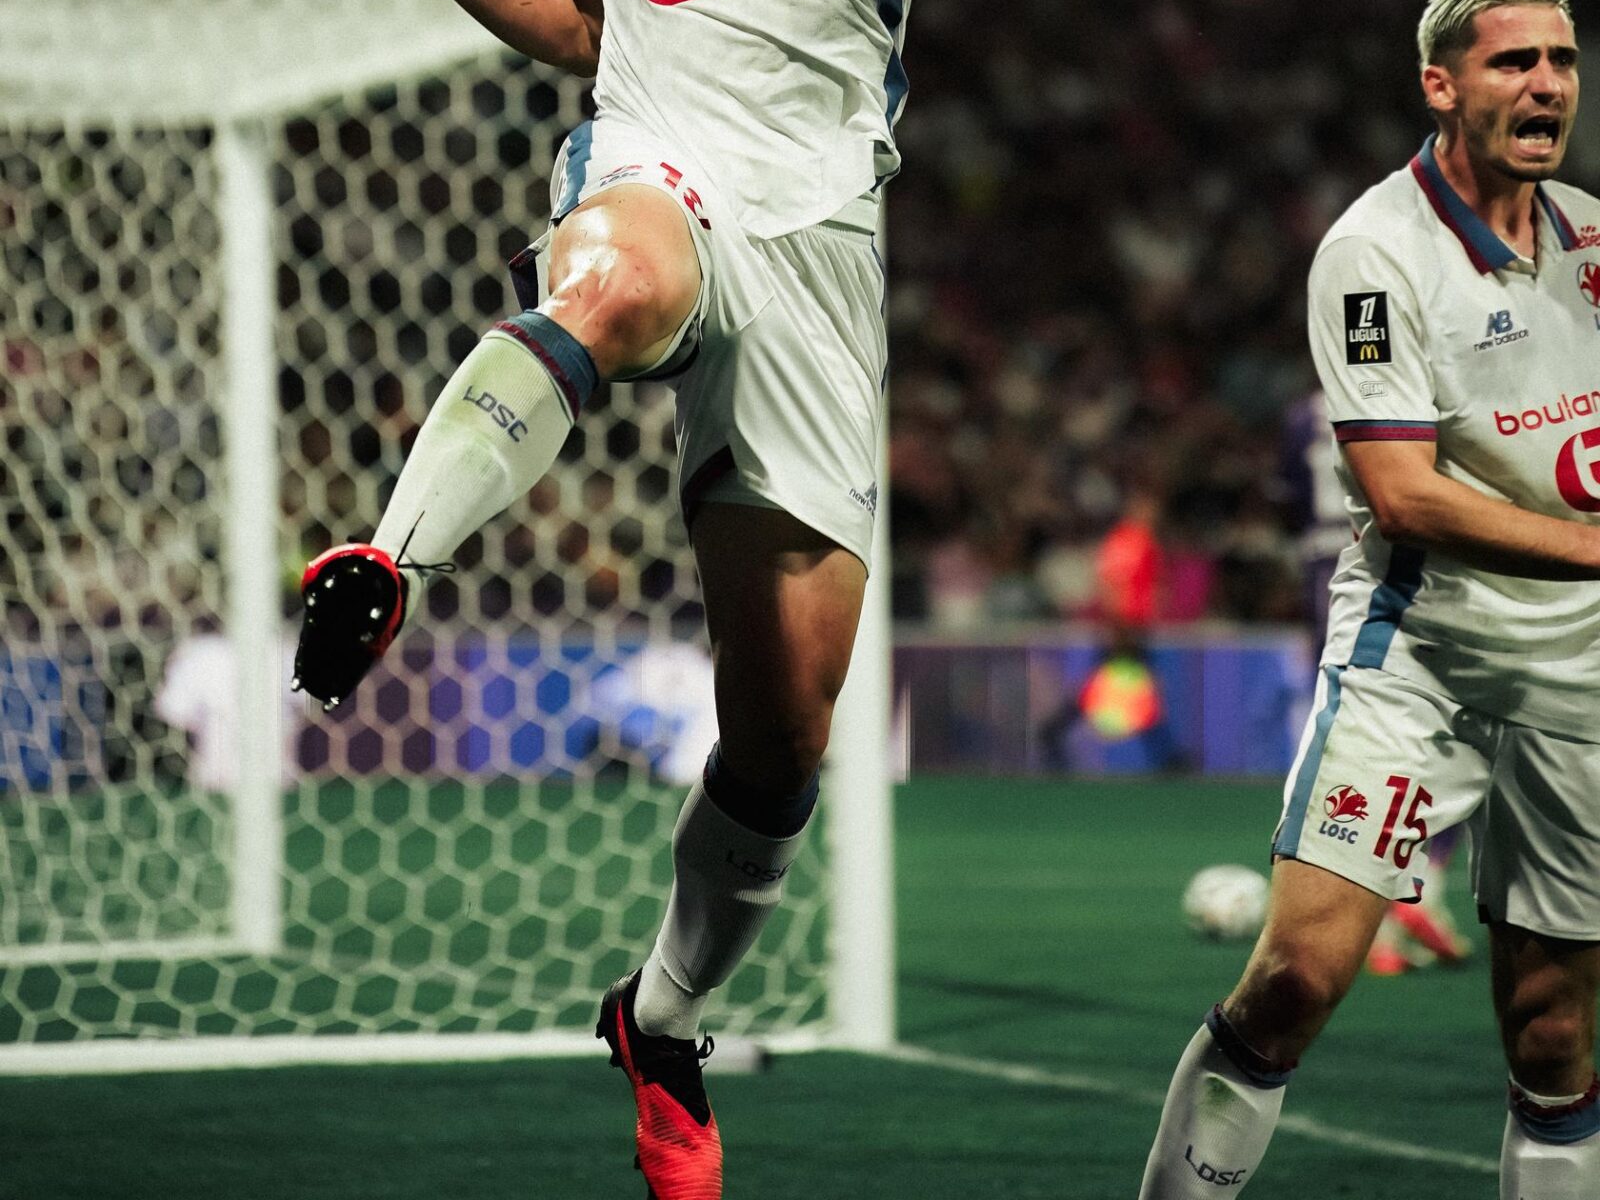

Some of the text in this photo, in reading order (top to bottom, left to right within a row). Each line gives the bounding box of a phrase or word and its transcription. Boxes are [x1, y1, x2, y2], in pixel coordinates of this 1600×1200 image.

[463, 385, 528, 442] LOSC
[1319, 820, 1359, 845] LOSC
[1373, 775, 1433, 870] 15
[1185, 1144, 1246, 1186] LOSC
